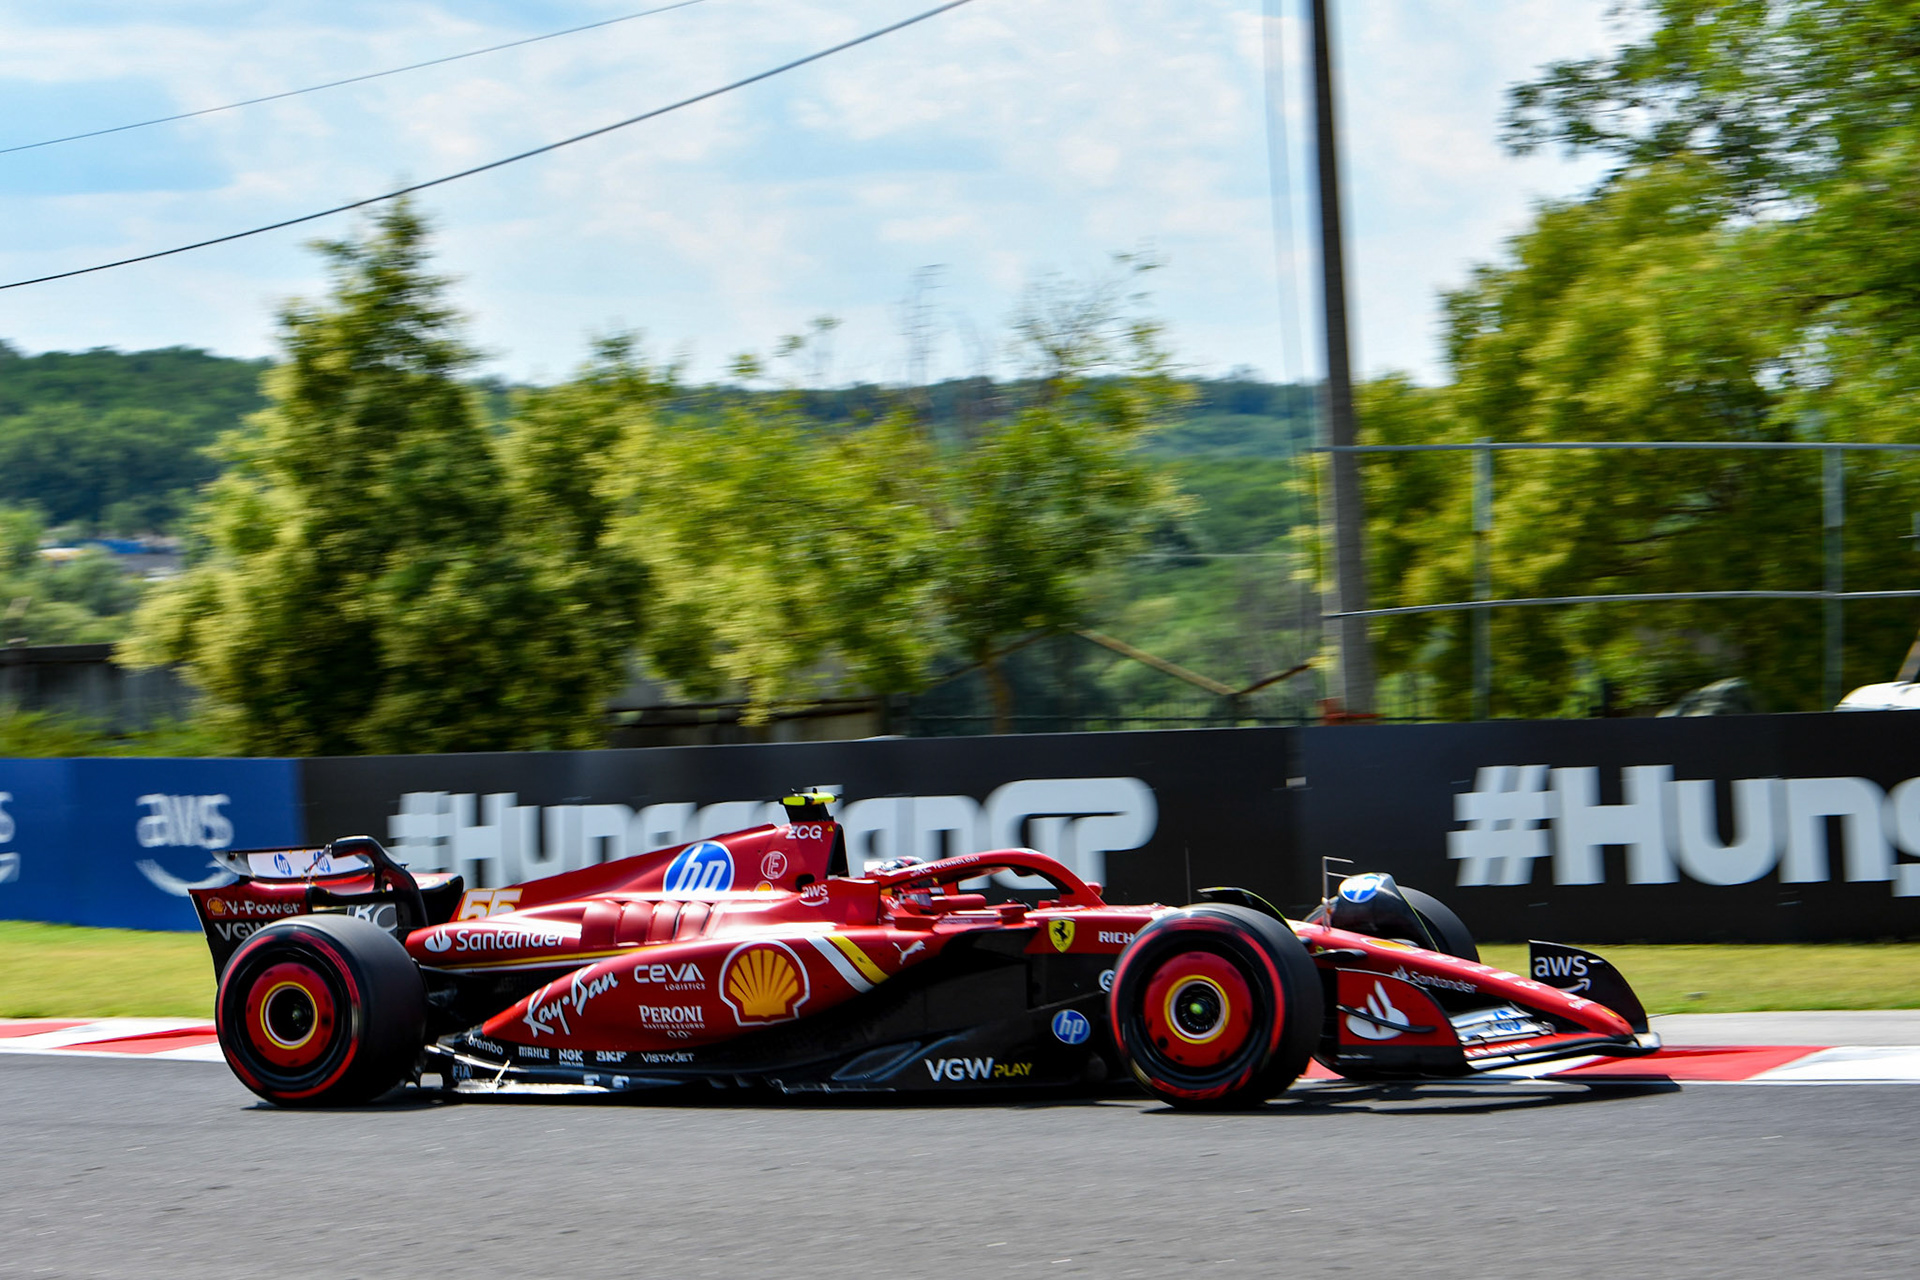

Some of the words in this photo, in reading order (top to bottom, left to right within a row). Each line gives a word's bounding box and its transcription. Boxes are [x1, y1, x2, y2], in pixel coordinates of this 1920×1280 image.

[135, 793, 235, 848] aws
[786, 824, 822, 840] ZCG
[801, 884, 828, 899] aws
[225, 900, 300, 915] V-Power
[457, 888, 523, 921] 55
[455, 929, 564, 951] Santander
[1534, 955, 1588, 977] aws
[664, 983, 706, 991] LOGISTICS
[1410, 971, 1477, 994] Santander
[638, 1005, 704, 1023] PERONI
[1056, 1010, 1086, 1043] hp
[468, 1033, 503, 1055] brembo
[518, 1046, 550, 1059] MAHLE
[558, 1049, 584, 1062] NGK
[596, 1050, 627, 1062] SKF
[924, 1057, 994, 1082] VGW
[994, 1063, 1033, 1078] PLAY
